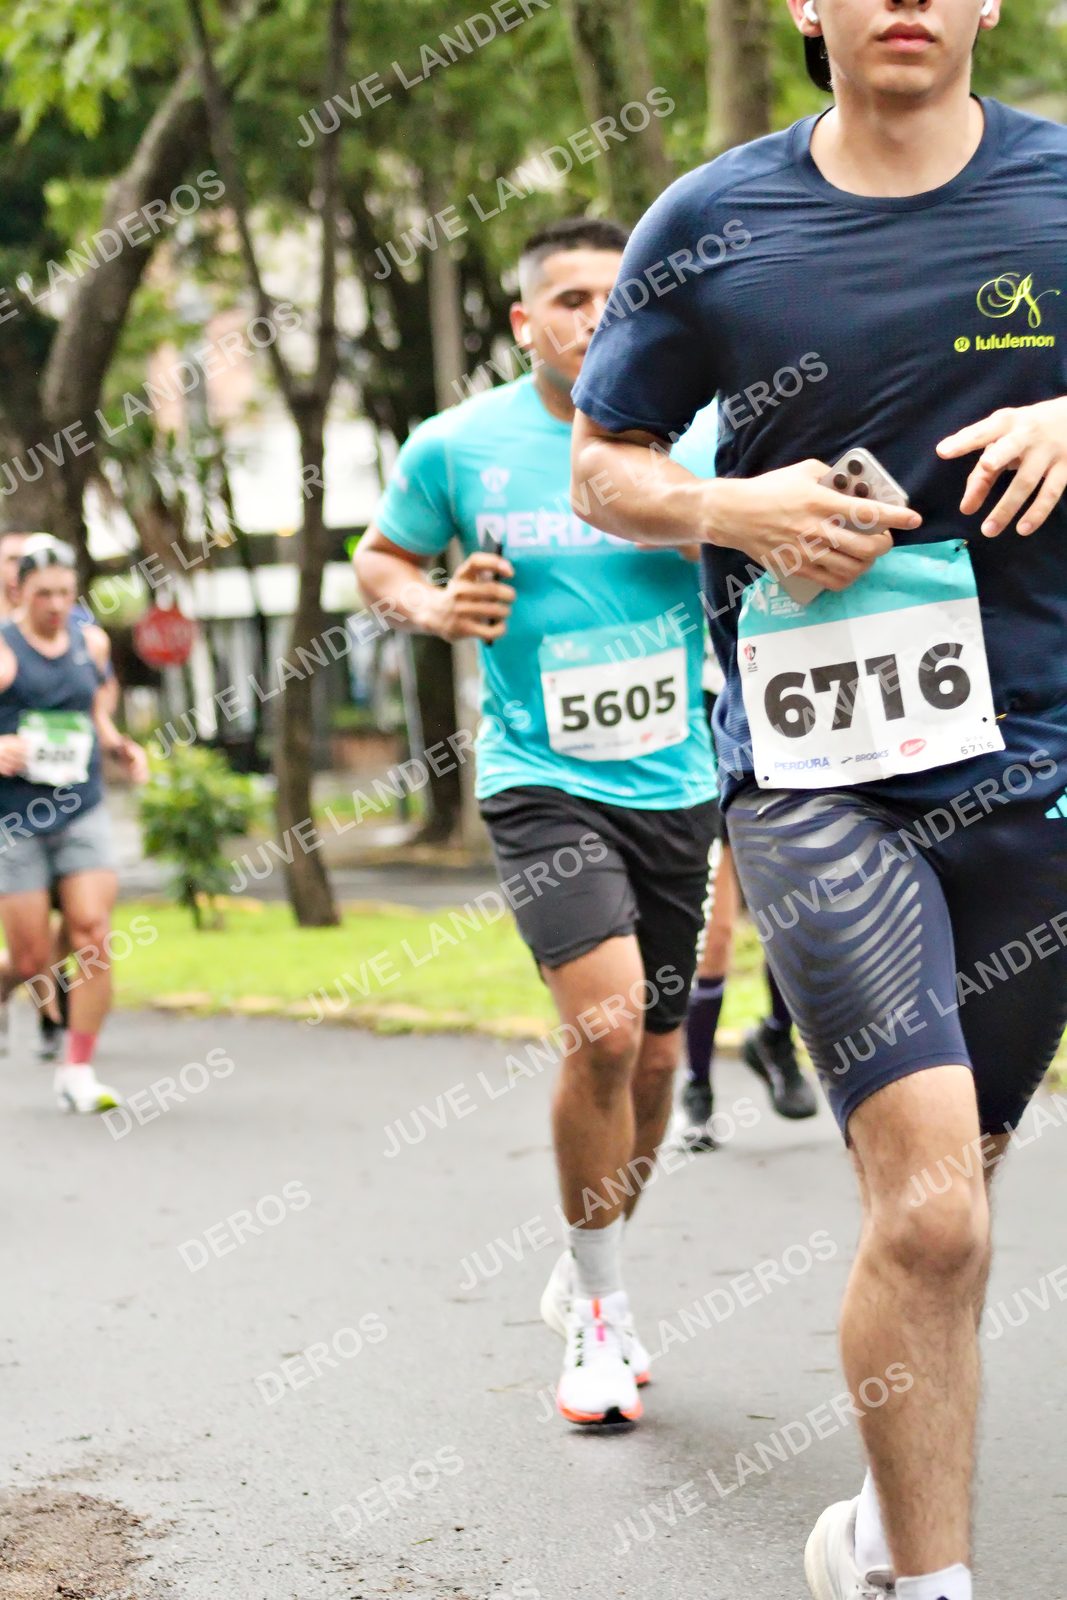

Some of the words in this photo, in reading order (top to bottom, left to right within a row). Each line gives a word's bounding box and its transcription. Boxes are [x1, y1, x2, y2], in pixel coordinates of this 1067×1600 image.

[975, 333, 1055, 351] lululemon
[475, 511, 636, 549] PERD
[560, 676, 676, 732] 5605
[764, 642, 971, 738] 6716
